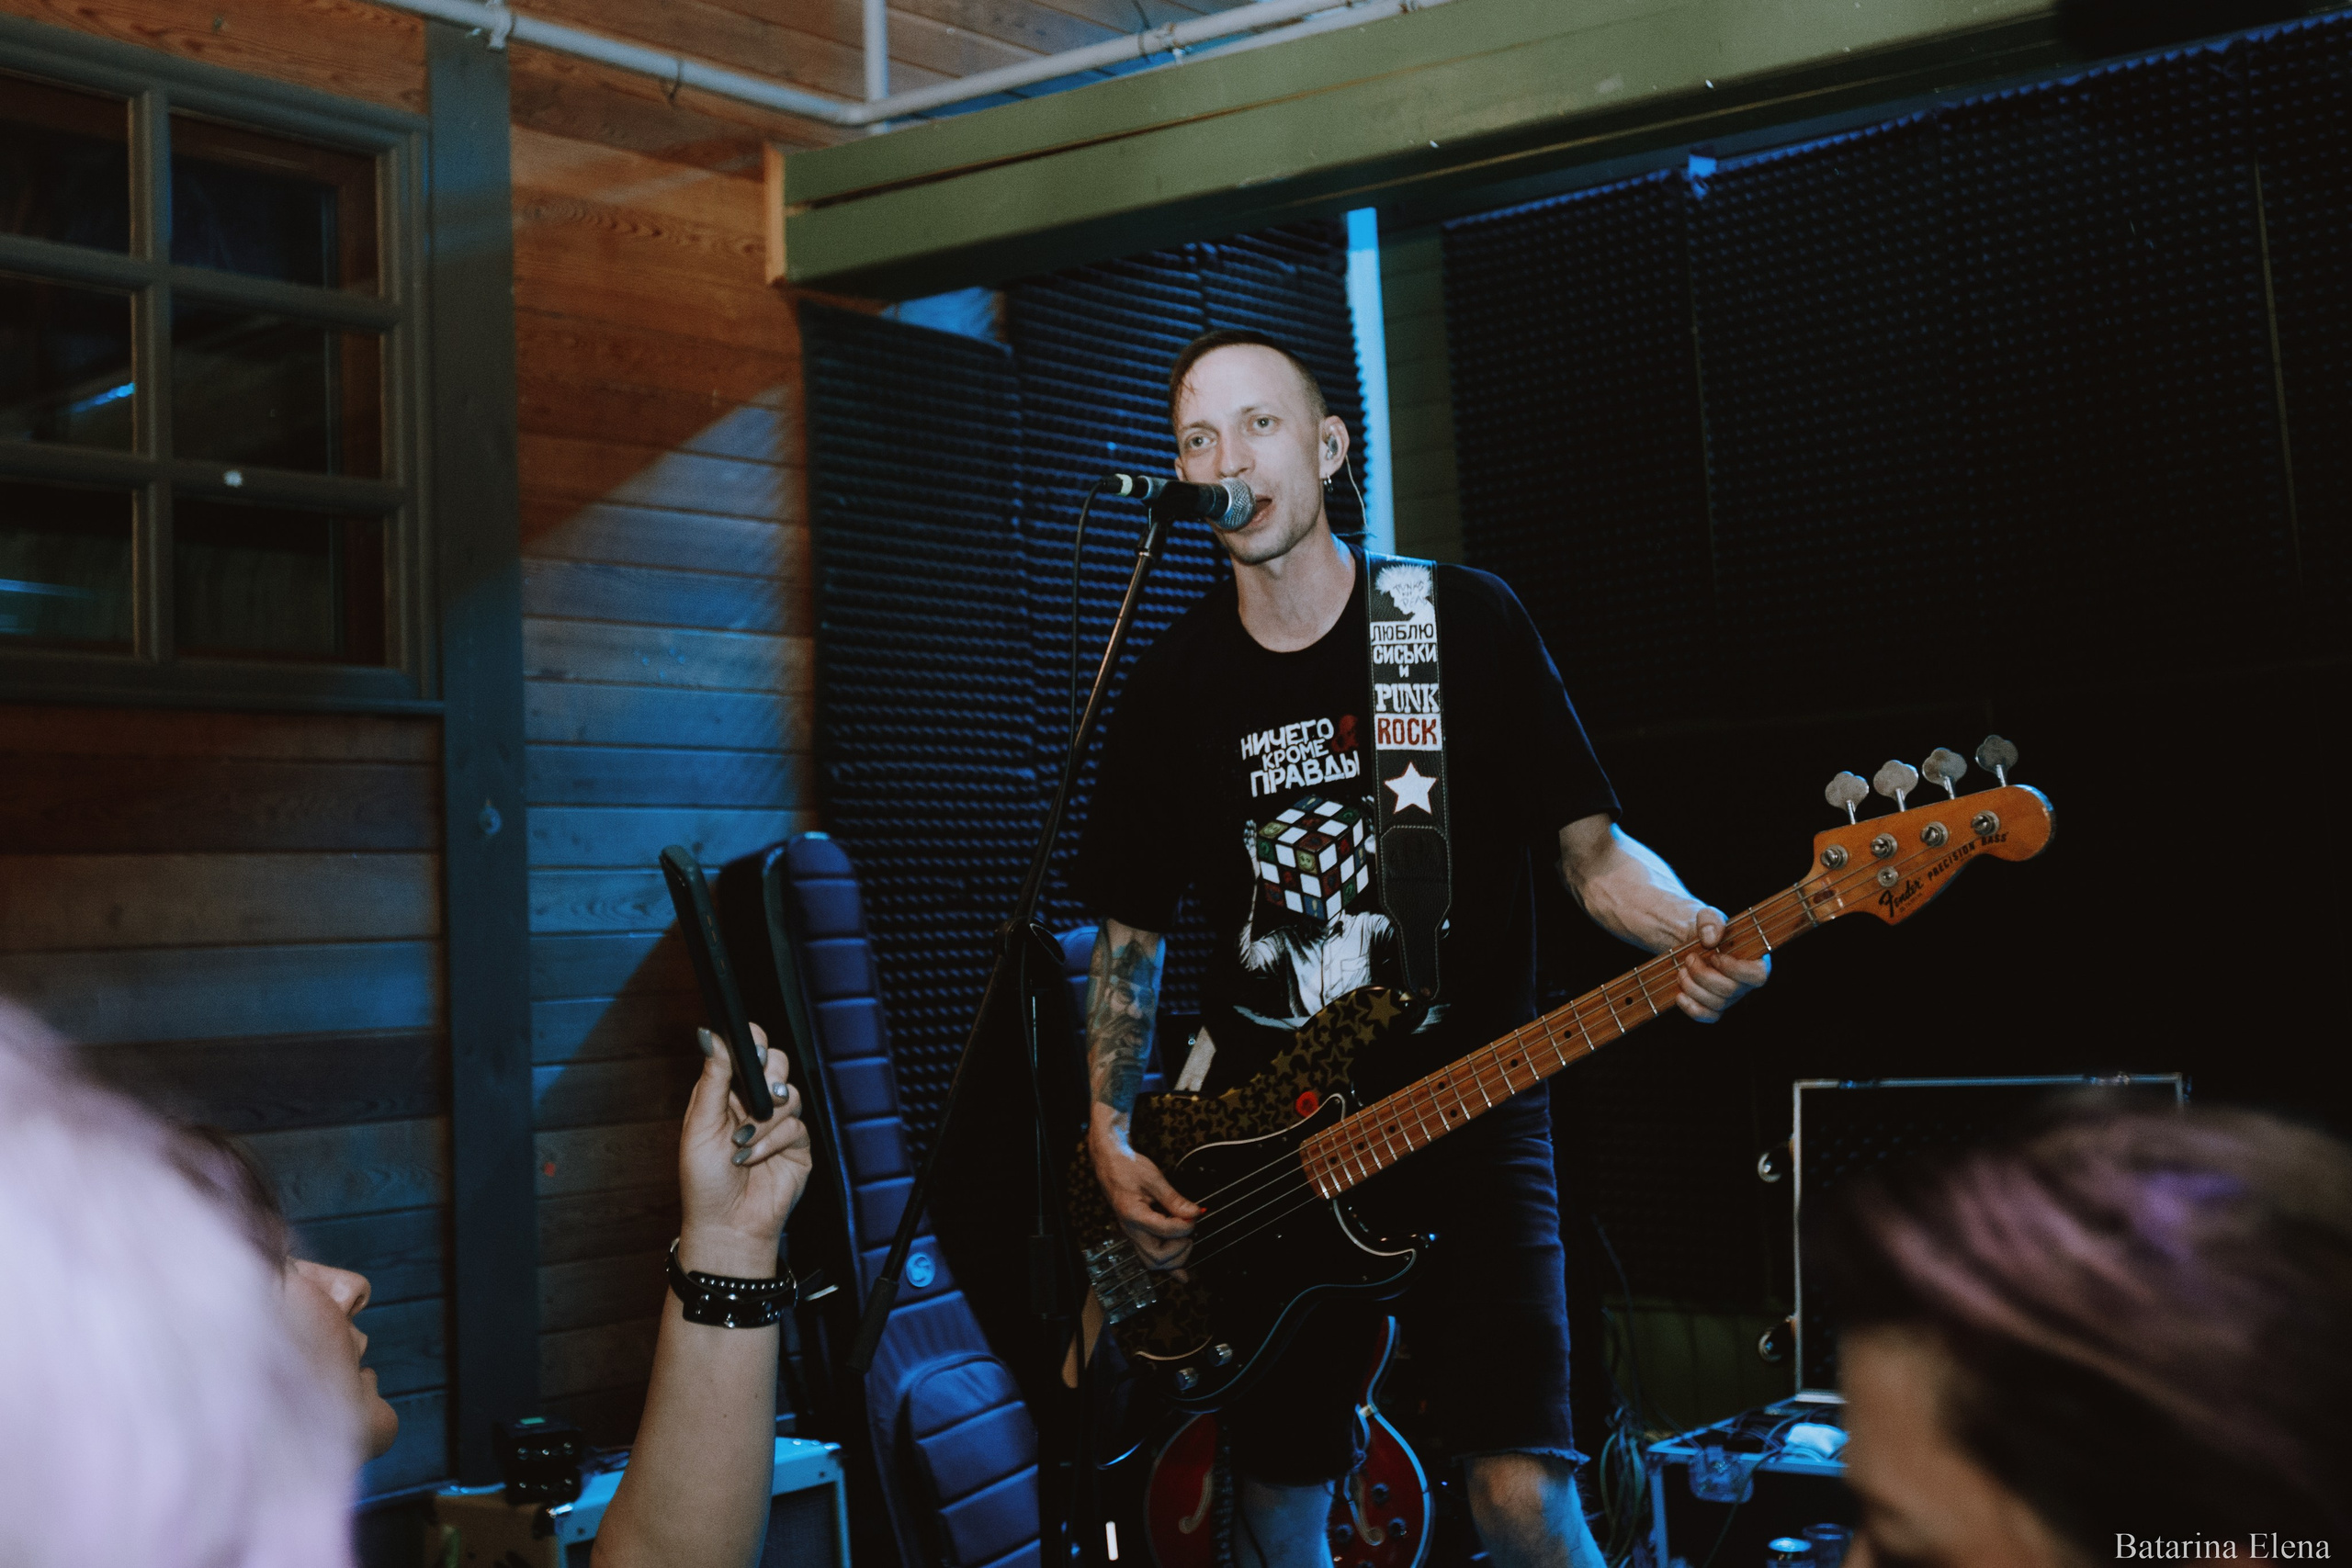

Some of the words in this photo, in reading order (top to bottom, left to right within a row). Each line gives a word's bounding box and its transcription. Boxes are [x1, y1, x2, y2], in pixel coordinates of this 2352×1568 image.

[1372, 623, 1434, 642] ЛЮБЛЮ
[1374, 644, 1437, 665] СИСЬКИ
[1374, 683, 1441, 713] PUNK
[1240, 717, 1334, 761] НИЧЕГО
[1377, 717, 1437, 745] ROCK
[1261, 739, 1329, 772] КРОМЕ
[1250, 750, 1360, 798] ПРАВДЫ
[1928, 841, 1975, 881] PRECISION
[1879, 878, 1924, 918] Fender
